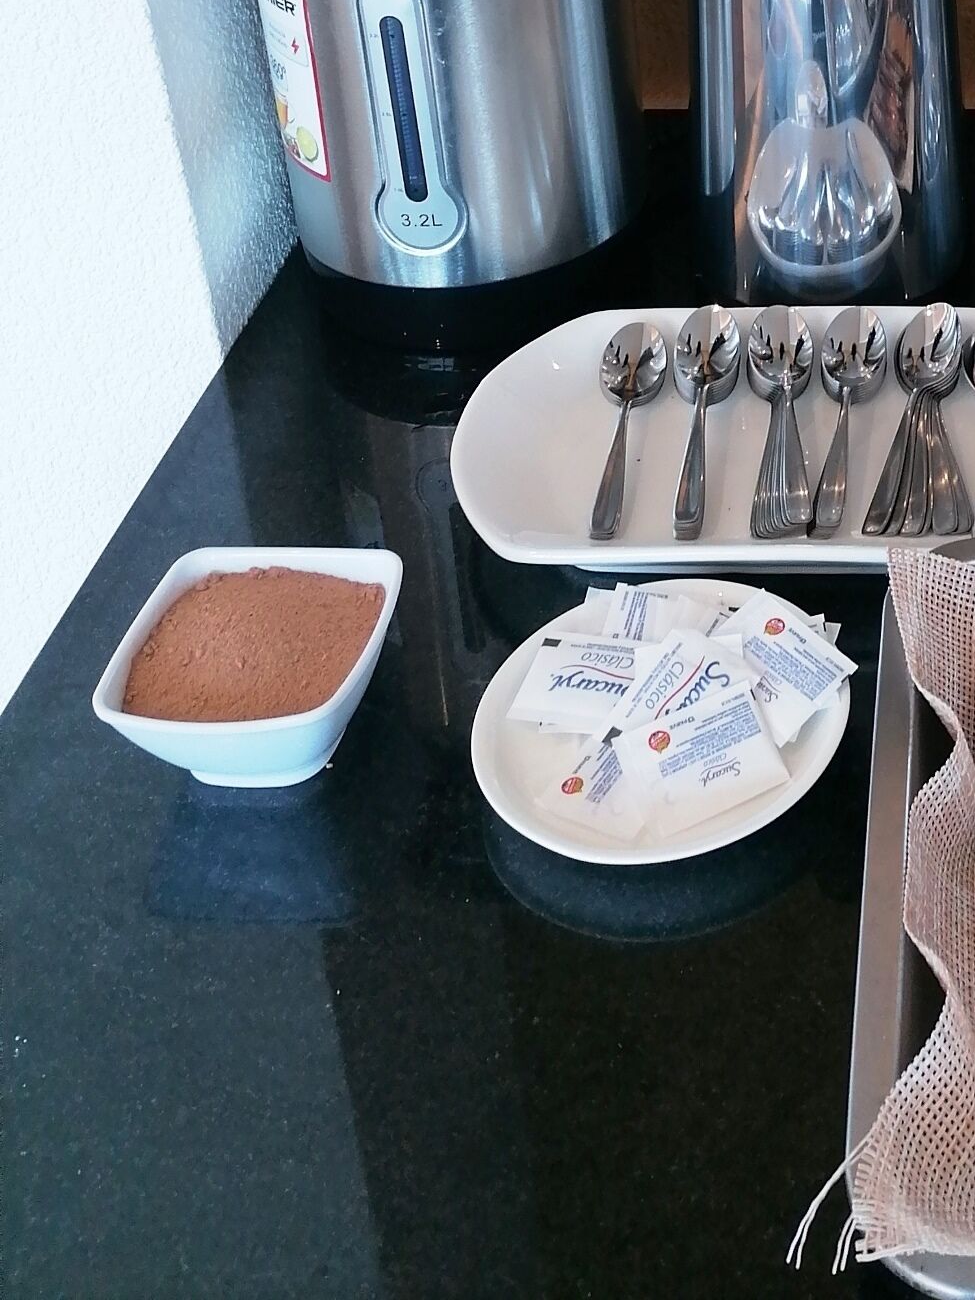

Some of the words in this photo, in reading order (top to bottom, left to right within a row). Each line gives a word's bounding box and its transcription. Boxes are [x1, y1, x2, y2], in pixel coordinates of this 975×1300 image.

[401, 213, 443, 227] 3.2L
[580, 651, 634, 669] Clásico
[645, 661, 684, 709] Clásico
[699, 760, 741, 788] Sucaryl
